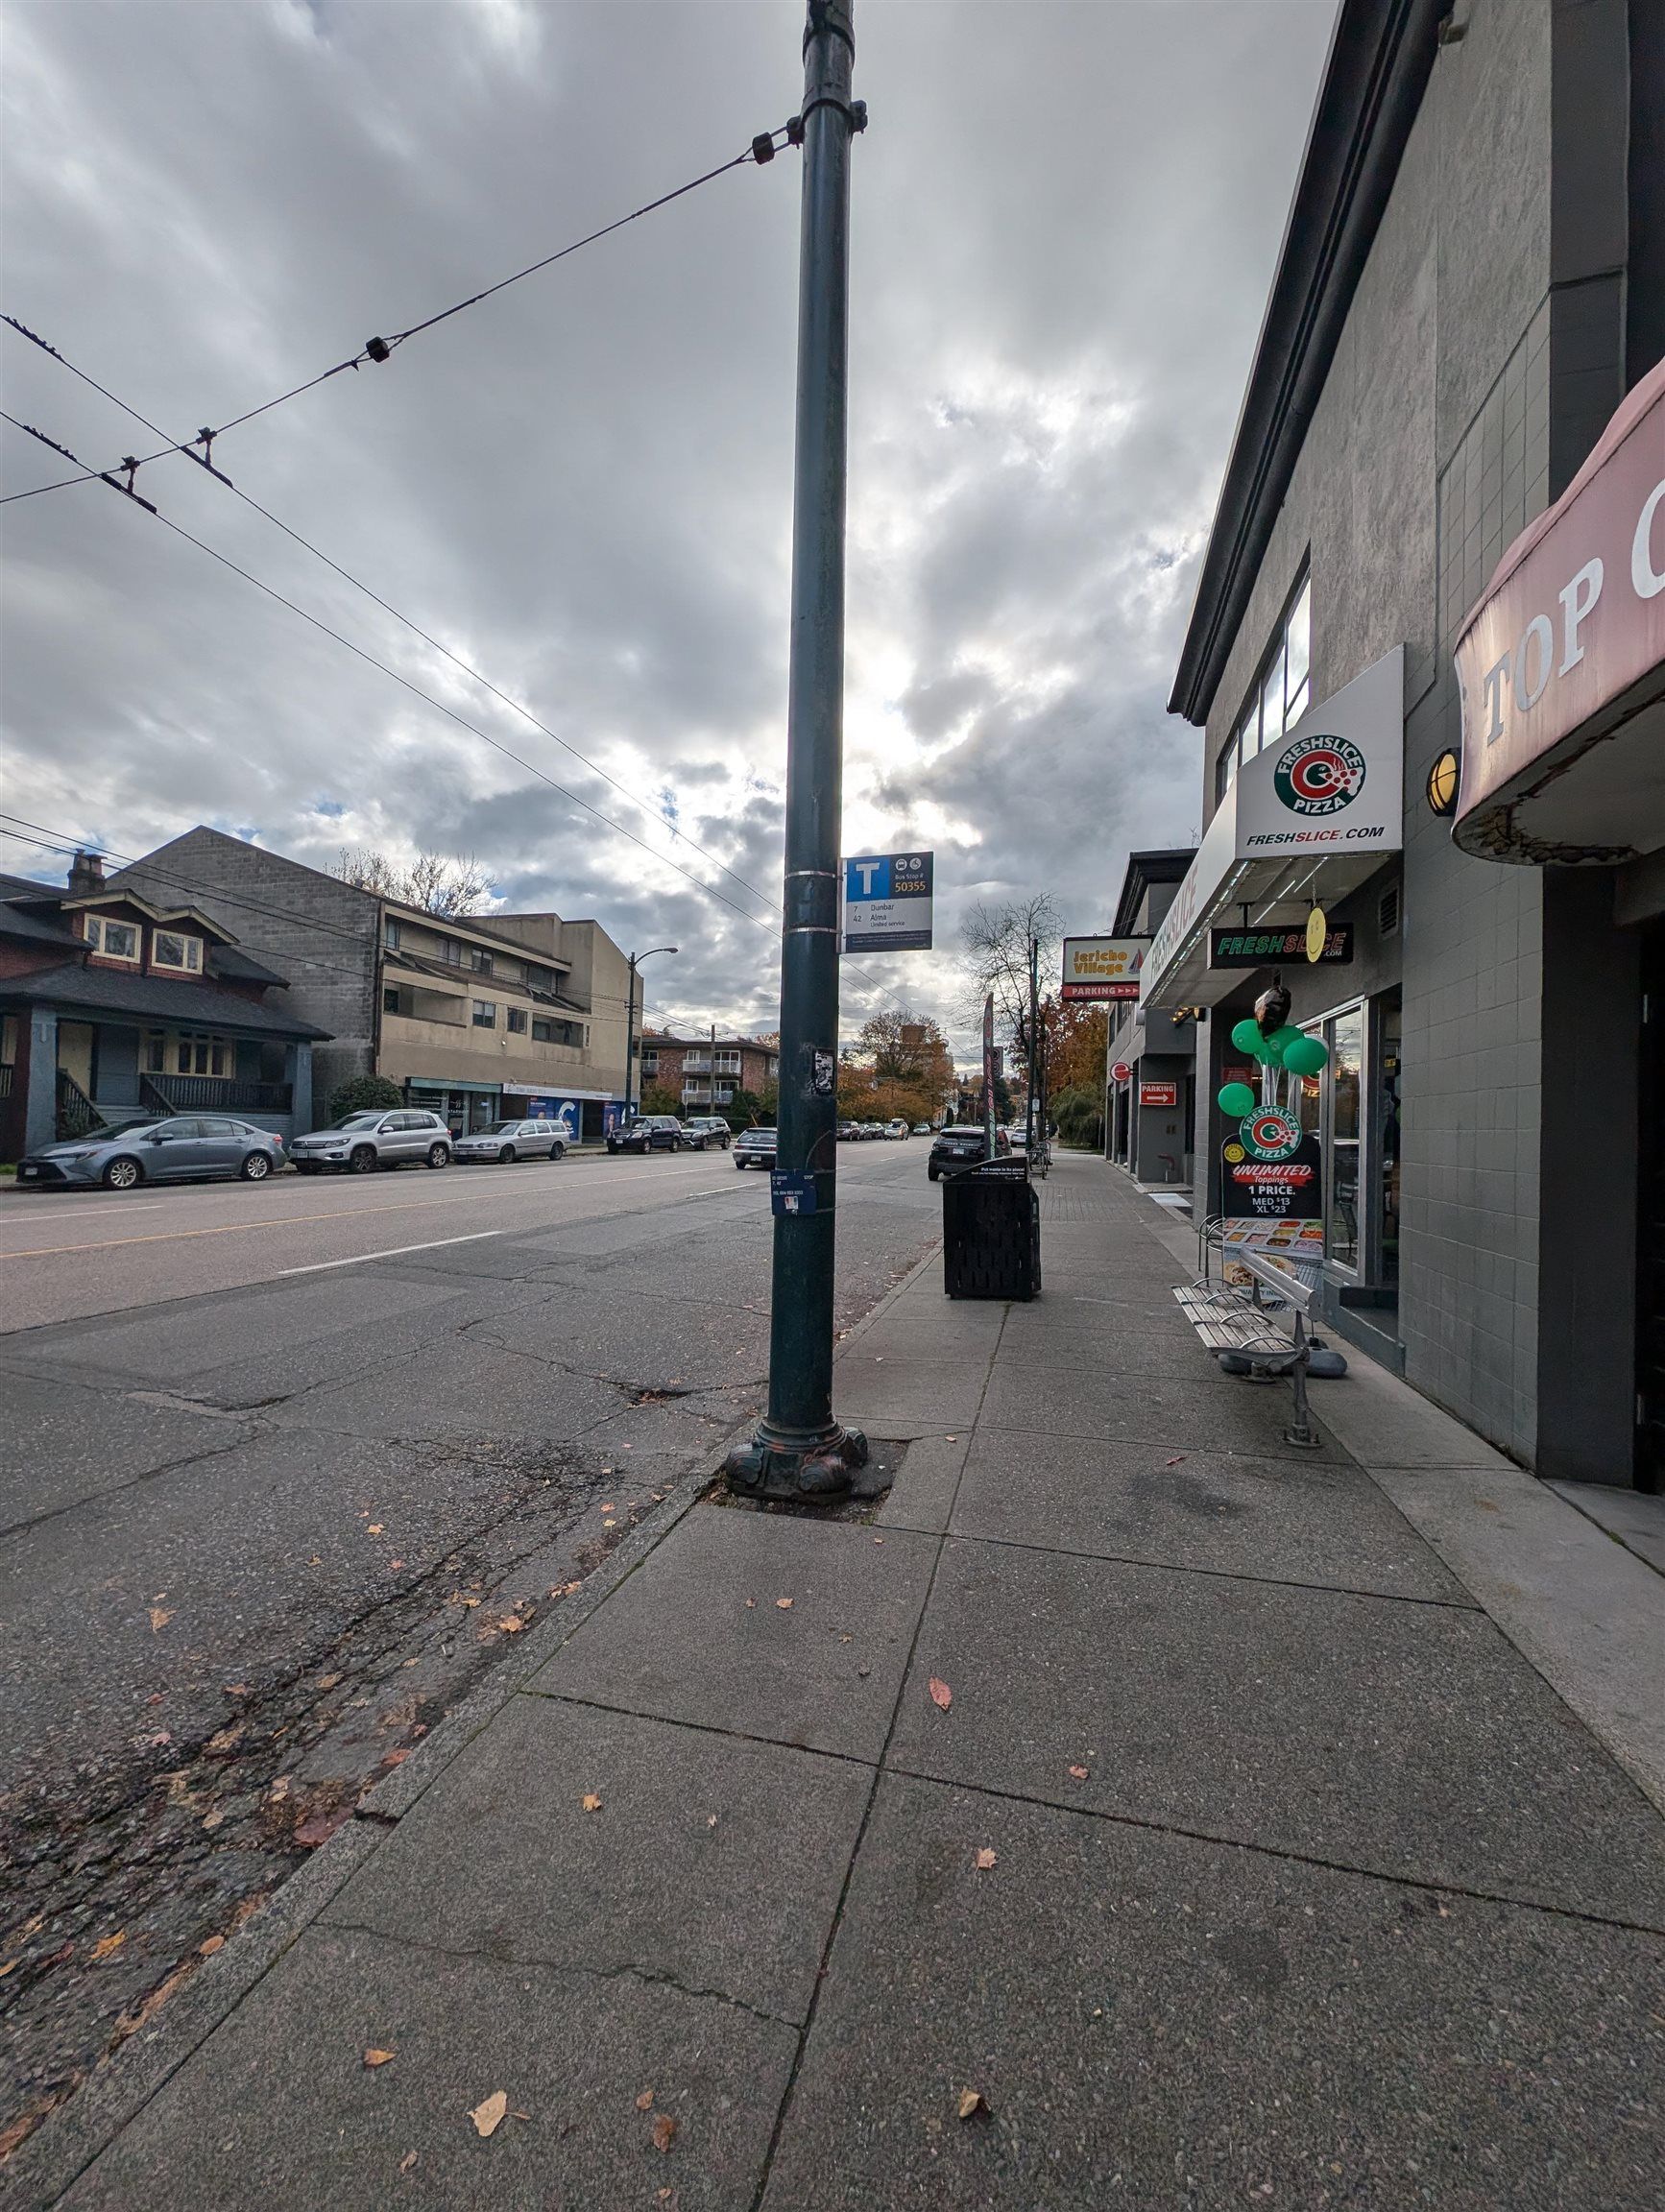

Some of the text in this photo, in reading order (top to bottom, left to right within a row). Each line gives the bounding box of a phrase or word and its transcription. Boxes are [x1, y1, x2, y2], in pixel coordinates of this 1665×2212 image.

[1483, 557, 1605, 747] TOP
[1278, 736, 1363, 774] FRESHSLICE
[1292, 796, 1346, 814] PIZZA
[1246, 827, 1385, 846] FRESHSLICE.COM
[856, 862, 880, 894] T
[895, 880, 926, 893] 50355
[1218, 932, 1347, 955] FRESHSLCE
[1074, 950, 1128, 963] Jericho
[1074, 961, 1123, 976] Village
[1072, 987, 1116, 996] PARKING
[1243, 1106, 1299, 1131] FRESHSLICE
[1254, 1147, 1290, 1159] PIZZA
[1232, 1165, 1312, 1177] UNLIMITED
[1254, 1176, 1289, 1186] Toppings
[1248, 1186, 1296, 1195] 1 PRICE.
[1252, 1197, 1291, 1206] MED $13
[1270, 1205, 1287, 1214] $23
